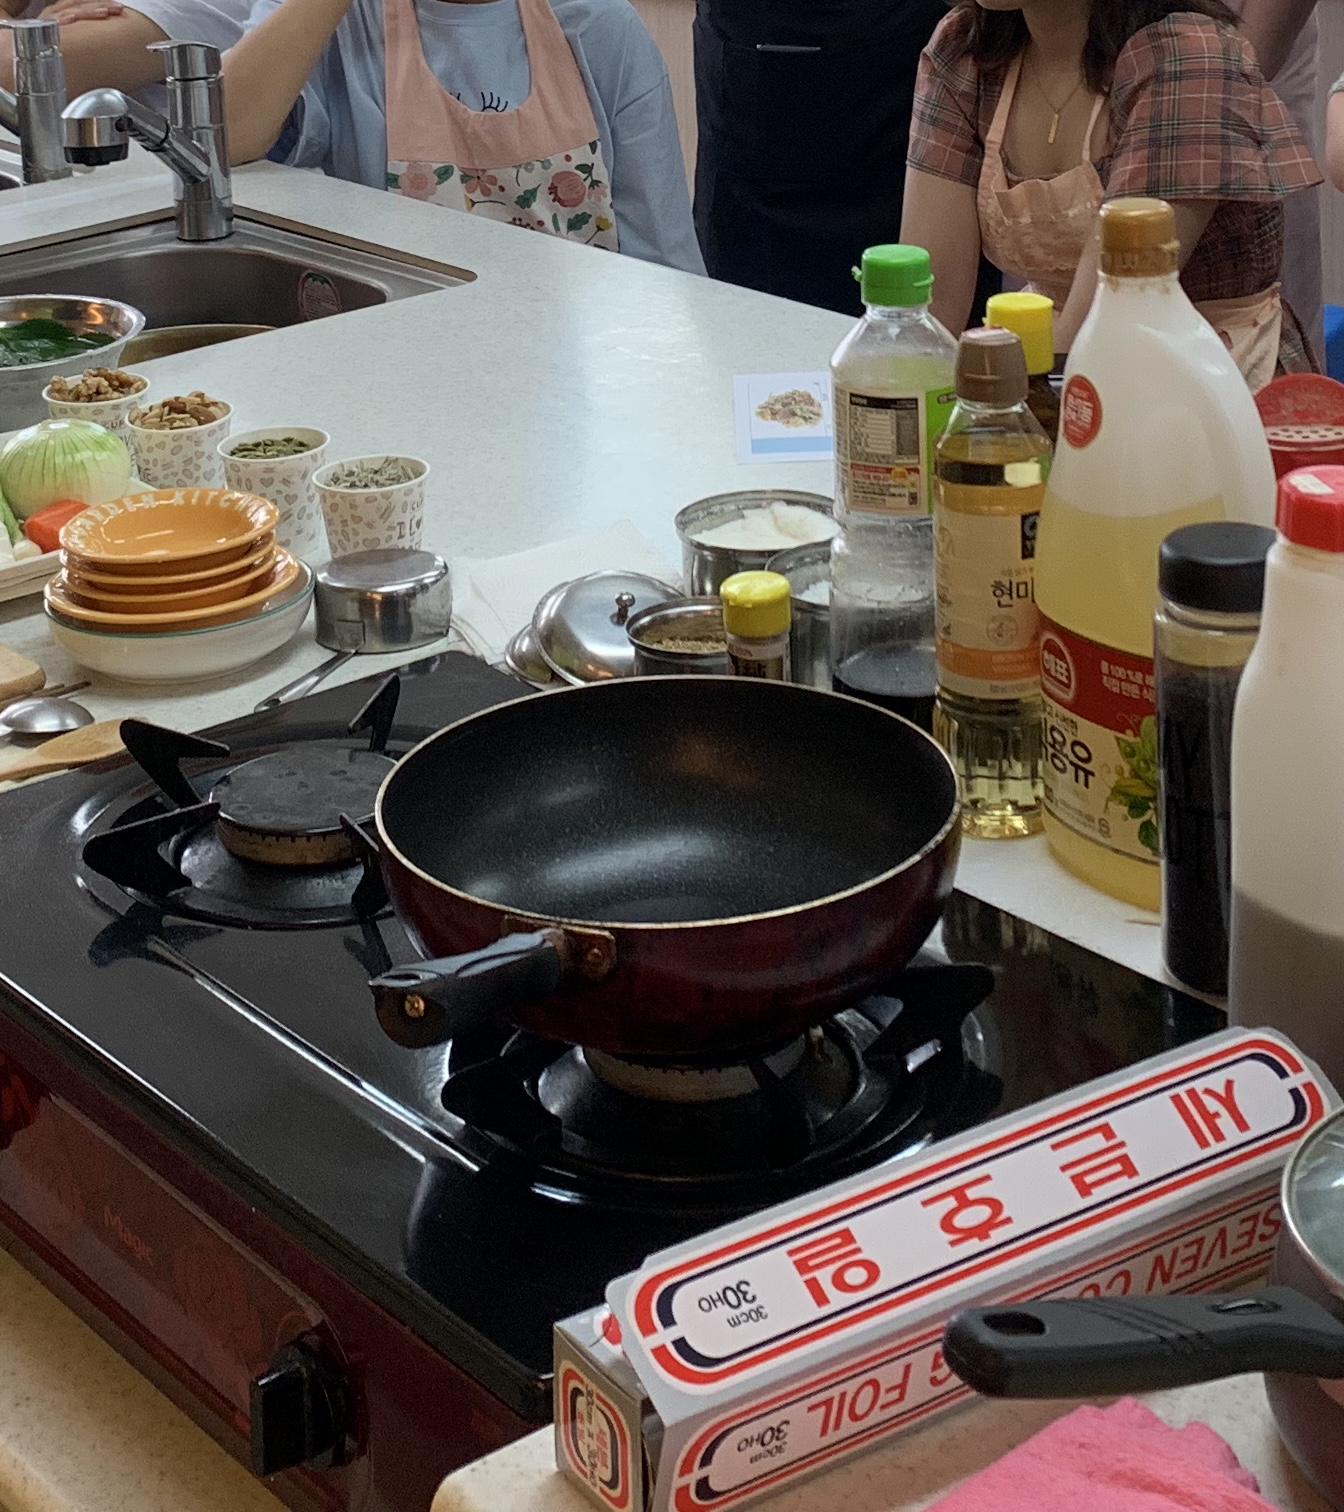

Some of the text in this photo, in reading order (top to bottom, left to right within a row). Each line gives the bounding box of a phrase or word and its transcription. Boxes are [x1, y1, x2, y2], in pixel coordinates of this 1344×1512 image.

[1144, 1202, 1281, 1292] SEVEN
[726, 1302, 770, 1329] 30cm
[806, 1361, 912, 1439] FOIL
[748, 1440, 789, 1465] 30cm
